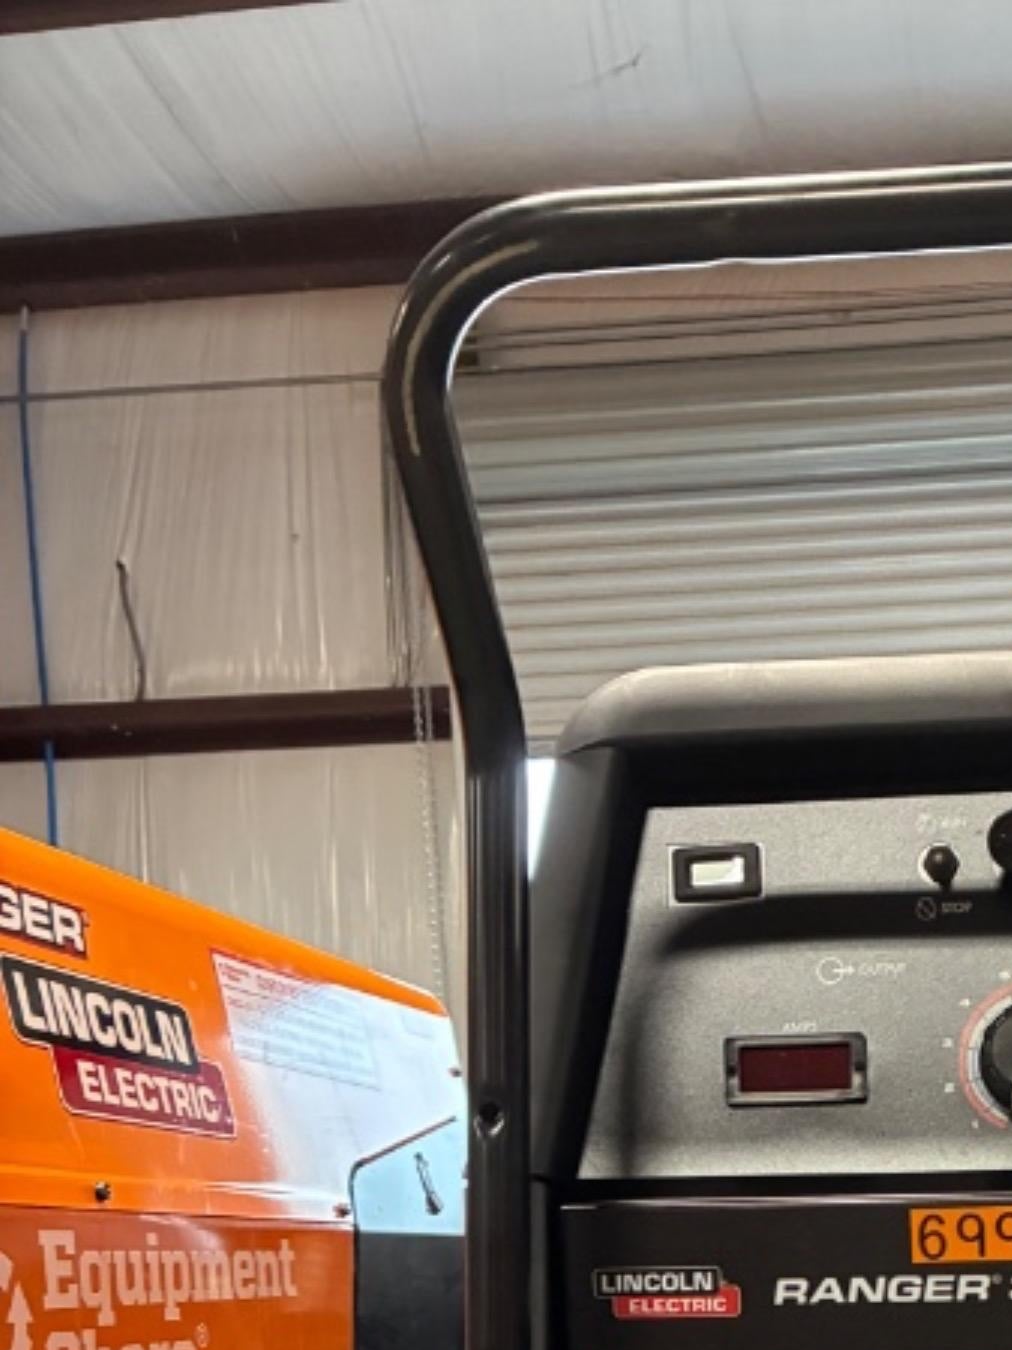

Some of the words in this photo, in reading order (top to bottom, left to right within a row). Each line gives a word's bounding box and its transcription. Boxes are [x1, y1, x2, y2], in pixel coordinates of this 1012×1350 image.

[12, 971, 193, 1065] LINCOLN
[76, 1058, 222, 1123] ELECTRIC
[37, 1229, 299, 1327] Equipment
[601, 1271, 714, 1294] LINCOLN
[629, 1297, 728, 1313] ELECTRIC
